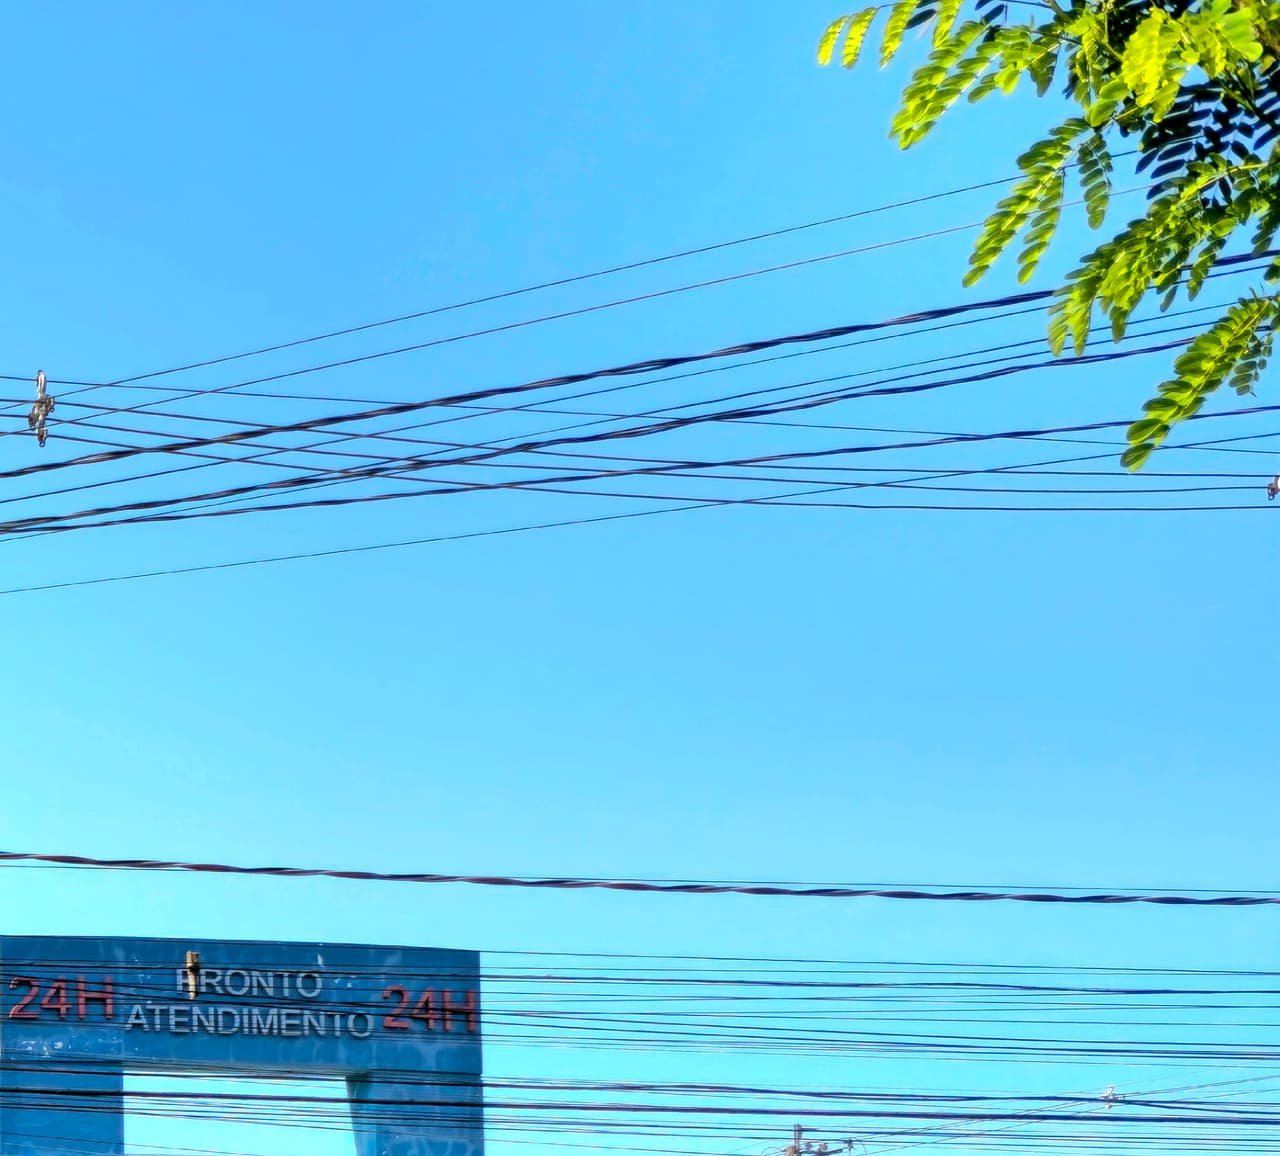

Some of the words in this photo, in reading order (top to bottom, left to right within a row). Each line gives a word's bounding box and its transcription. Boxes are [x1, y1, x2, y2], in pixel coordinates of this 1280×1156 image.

[8, 975, 115, 1020] 24H
[381, 985, 478, 1033] 24H
[125, 1003, 374, 1038] ATENDIMENTO
